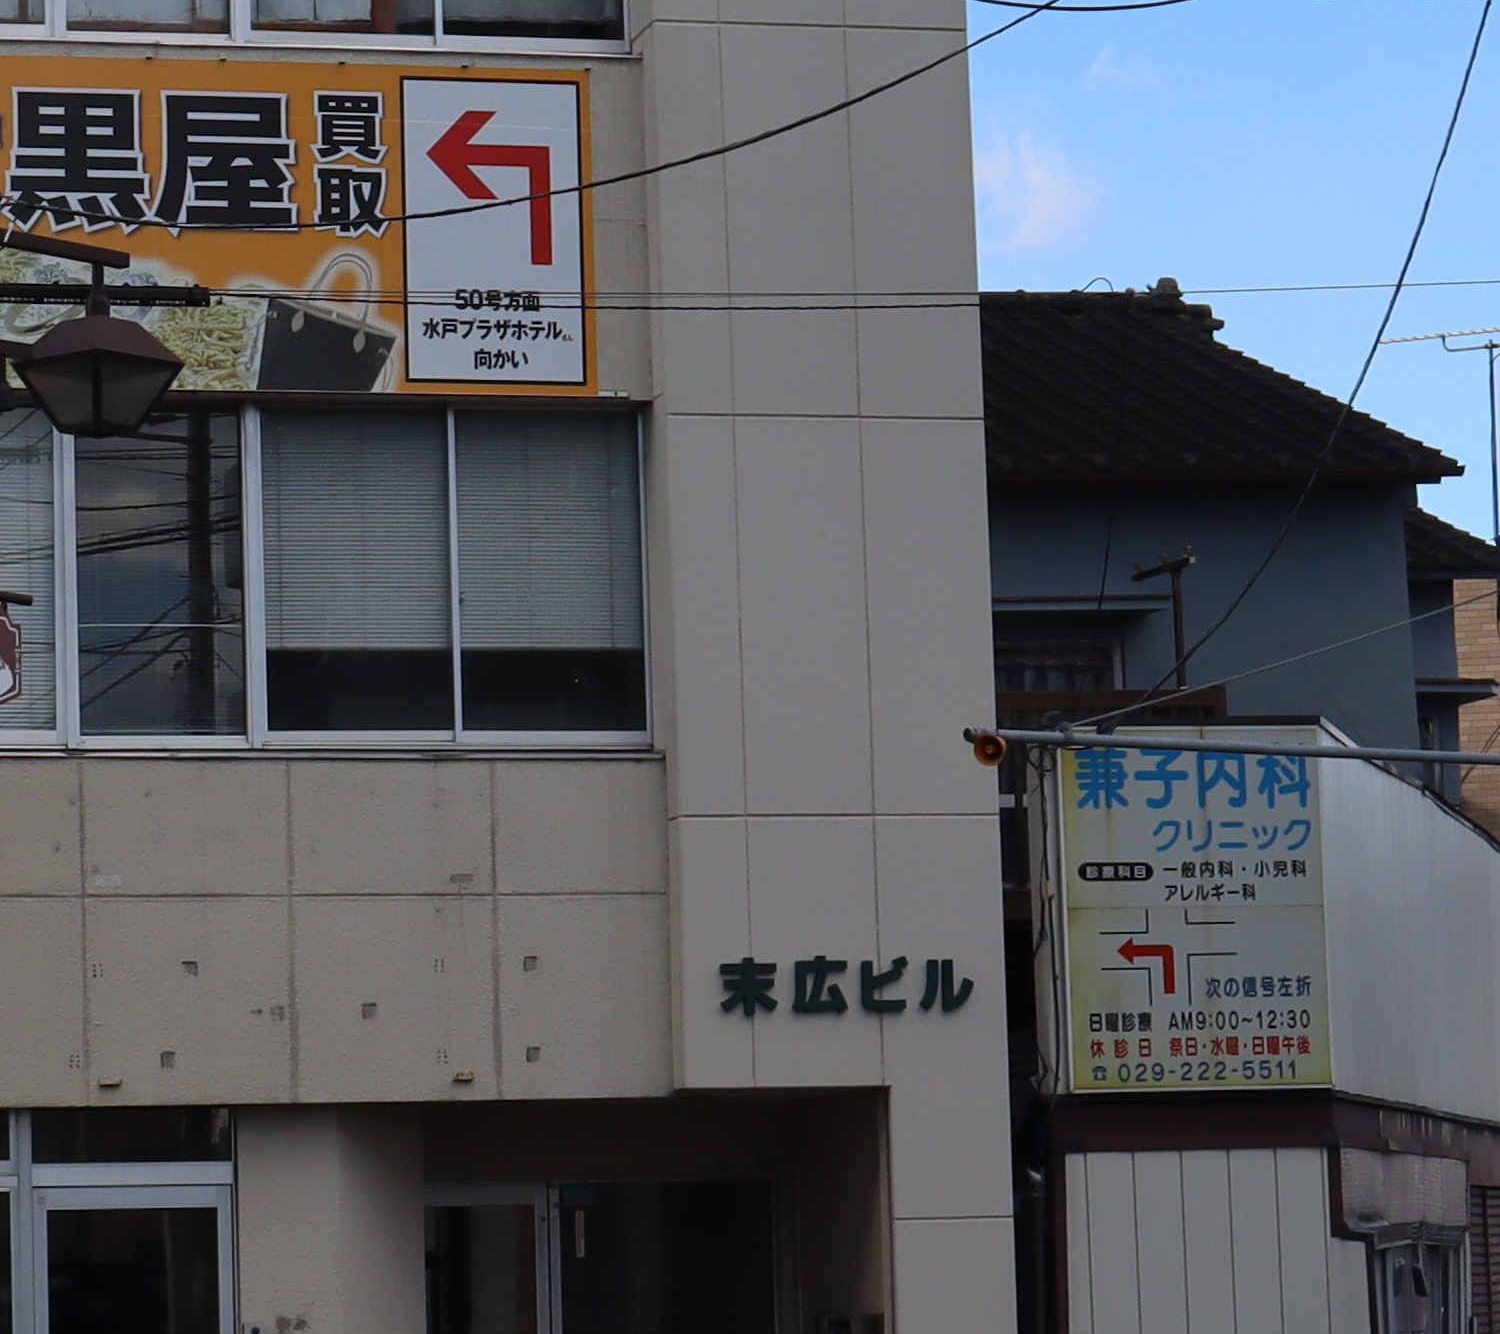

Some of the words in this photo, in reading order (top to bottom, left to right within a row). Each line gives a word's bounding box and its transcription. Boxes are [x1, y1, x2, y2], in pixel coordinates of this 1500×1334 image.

[309, 89, 391, 239] 買取
[455, 288, 541, 312] 50号方面
[474, 348, 529, 370] 向かい
[1073, 744, 1311, 810] 兼子内科
[1152, 819, 1312, 852] クリニック
[1085, 865, 1148, 880] 診療科目
[1162, 859, 1307, 879] 一般内科・小児科
[1164, 883, 1257, 902] アレルギー科
[719, 955, 975, 1017] 末広ビル
[1206, 975, 1312, 999] 次の信号左折
[1089, 1012, 1153, 1033] 日曜診療
[1169, 1035, 1312, 1057] 祭日・水曜・日曜午後
[1117, 1059, 1298, 1083] 029-222-5511
